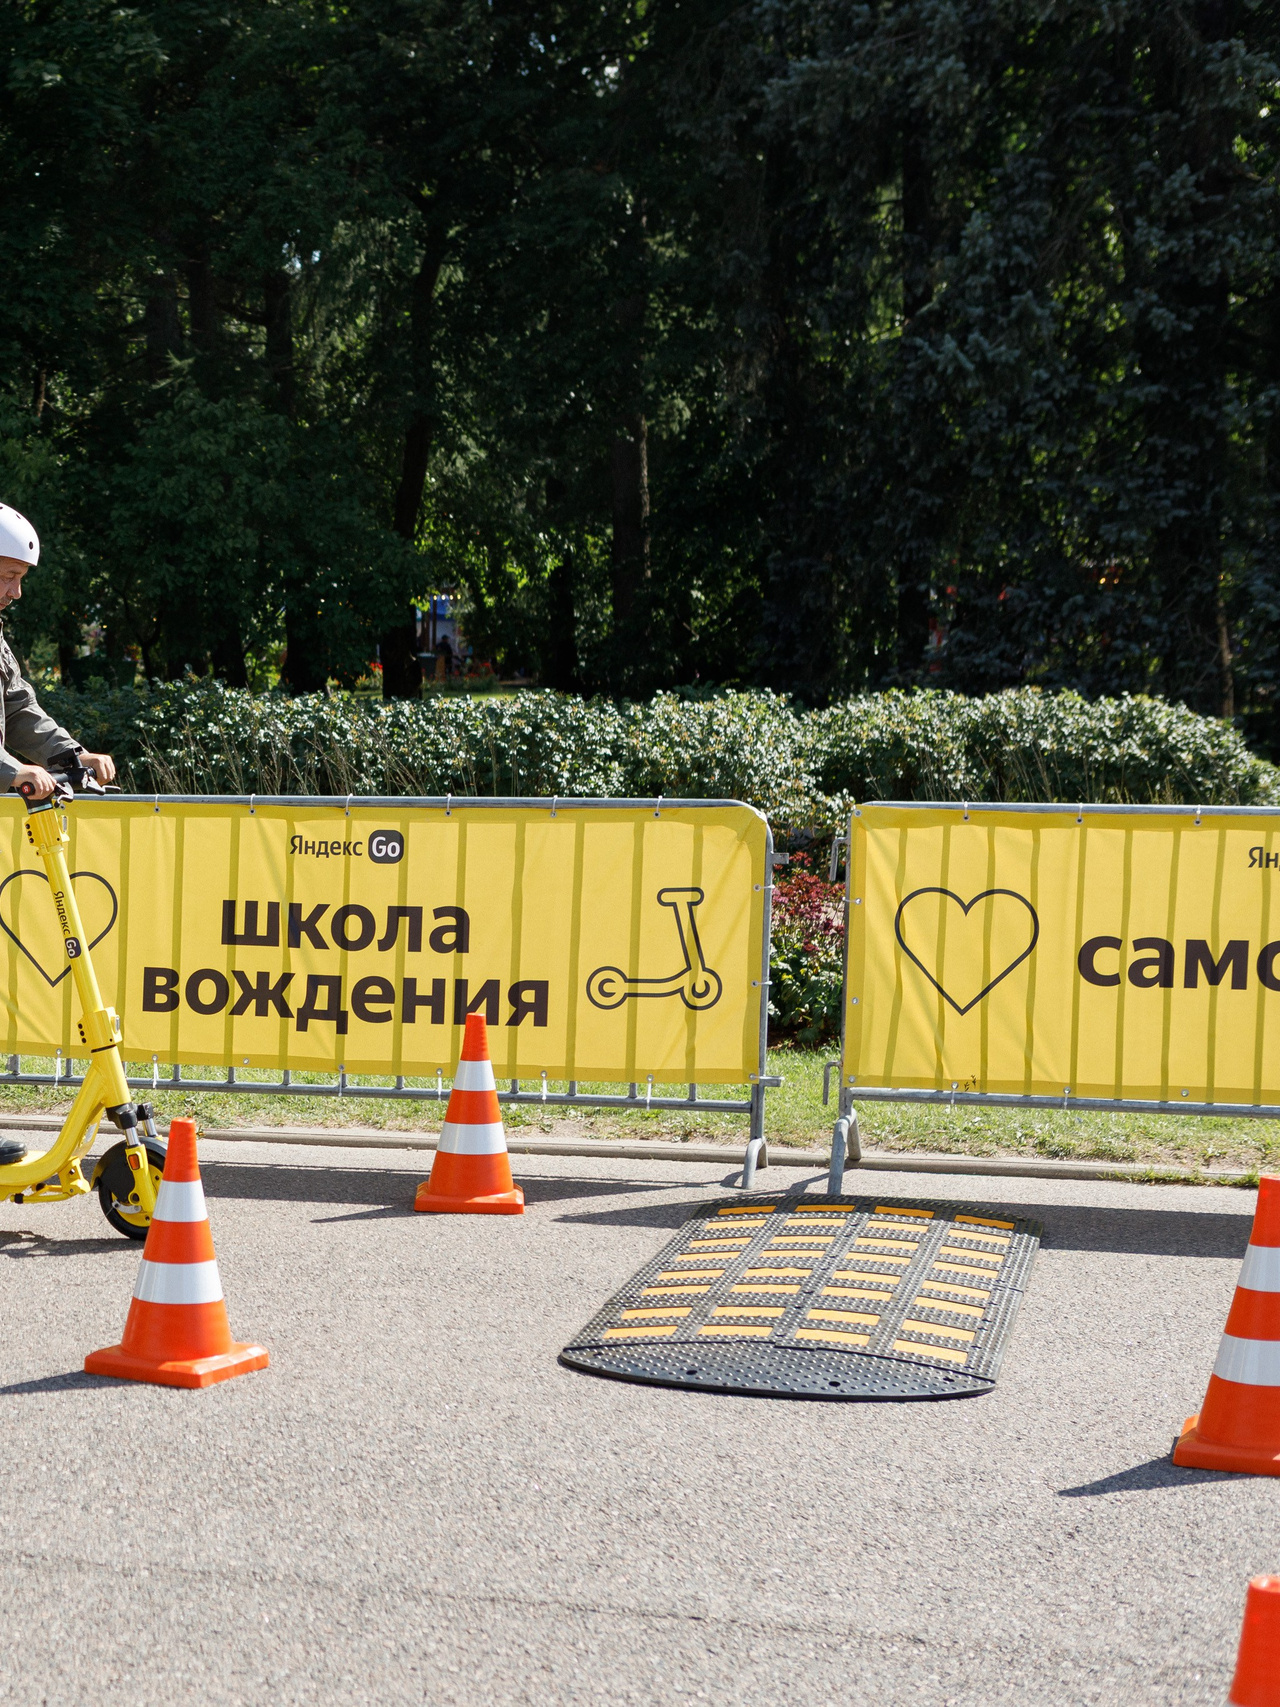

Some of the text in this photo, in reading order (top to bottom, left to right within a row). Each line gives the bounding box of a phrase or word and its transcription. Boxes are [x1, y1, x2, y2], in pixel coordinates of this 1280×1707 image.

[290, 835, 401, 859] Яндекс Go
[54, 891, 77, 957] Яндекс Go
[221, 900, 470, 954] школа
[142, 966, 549, 1035] вождения
